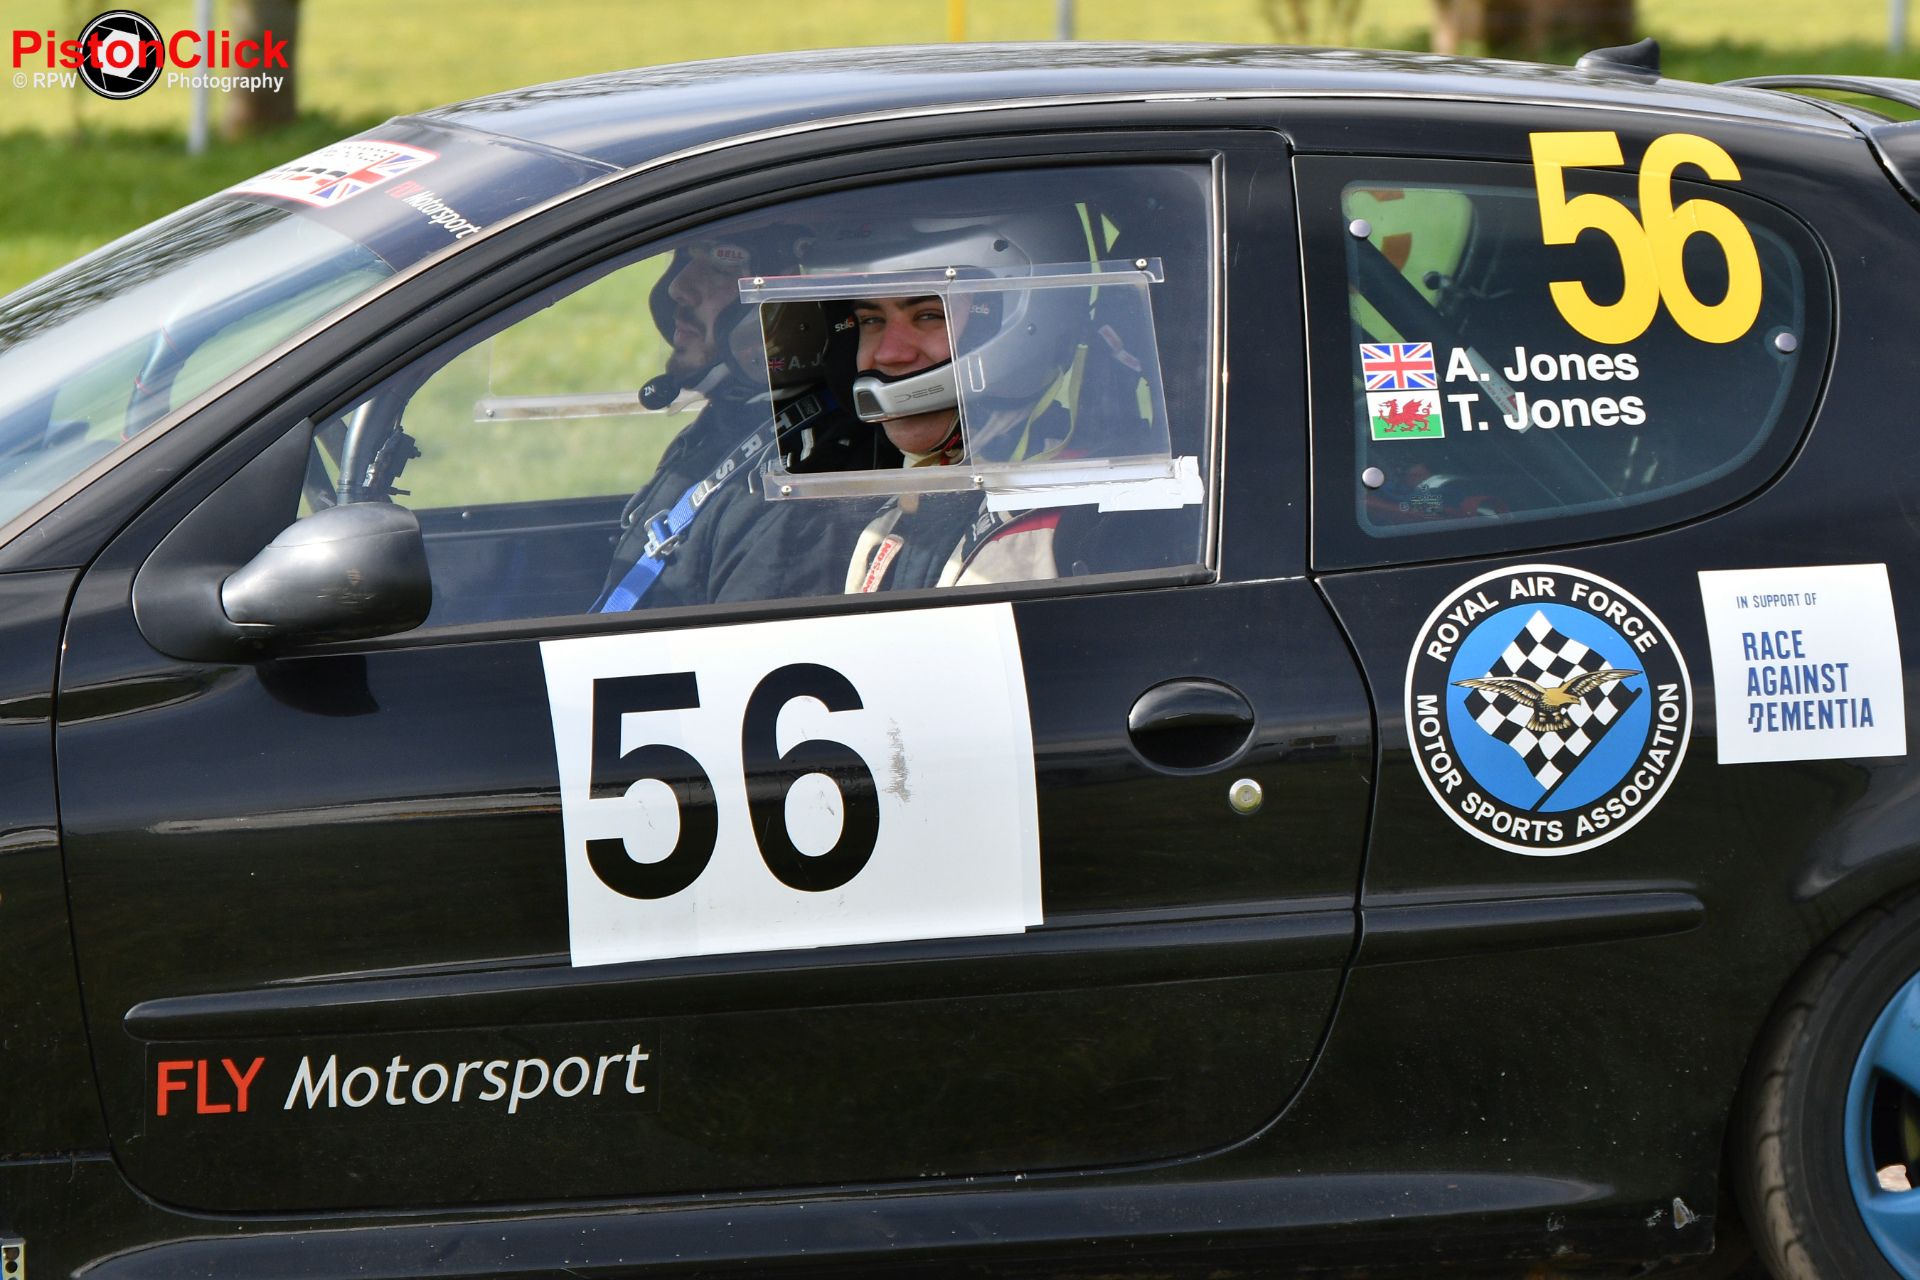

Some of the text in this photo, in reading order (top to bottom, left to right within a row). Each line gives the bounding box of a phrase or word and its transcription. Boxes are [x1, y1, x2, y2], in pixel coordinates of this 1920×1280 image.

[402, 190, 482, 239] Motorsport
[1528, 130, 1763, 344] 56
[1445, 346, 1640, 383] A. Jones
[1447, 393, 1489, 432] T.
[1502, 391, 1647, 432] Jones
[1426, 576, 1658, 663] ROYAL AIR FORCE
[1736, 592, 1817, 609] IN SUPPORT OF
[1742, 630, 1806, 661] RACE
[1747, 663, 1849, 697] AGAINST
[1748, 698, 1874, 733] DEMENTIA
[586, 662, 880, 900] 56
[1416, 682, 1680, 842] MOTOR SPORTS ASSOCIATION
[156, 1043, 650, 1116] FLY Motorsport
